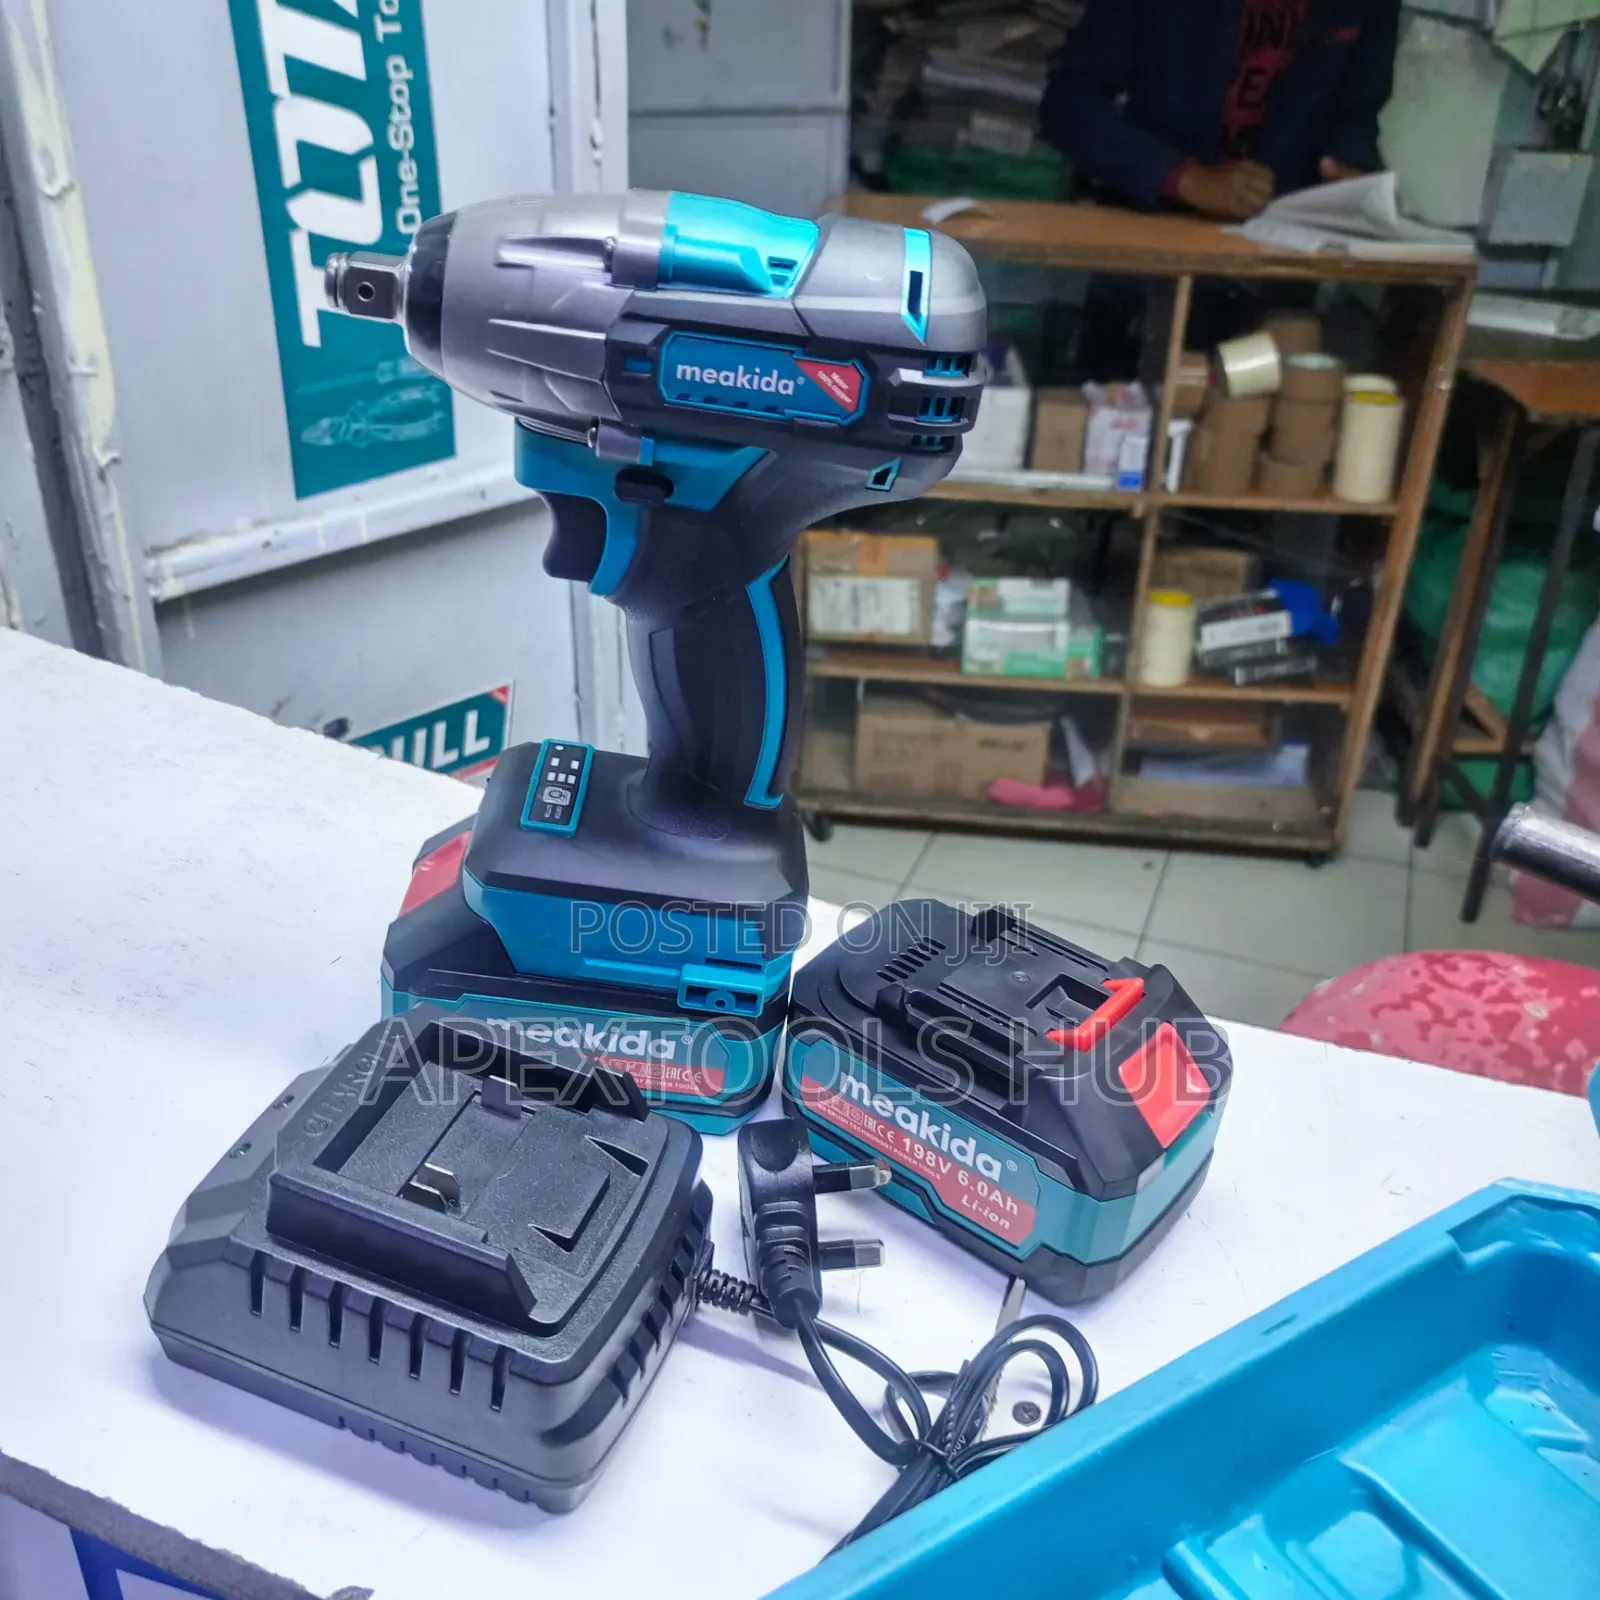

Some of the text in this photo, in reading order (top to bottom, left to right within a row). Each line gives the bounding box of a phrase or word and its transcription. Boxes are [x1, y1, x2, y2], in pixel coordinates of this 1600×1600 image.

[386, 55, 422, 234] One-Stop
[902, 1137, 953, 1175] 198V
[957, 1168, 1020, 1217] 6.0Ah
[961, 1193, 1011, 1231] Li-ion
